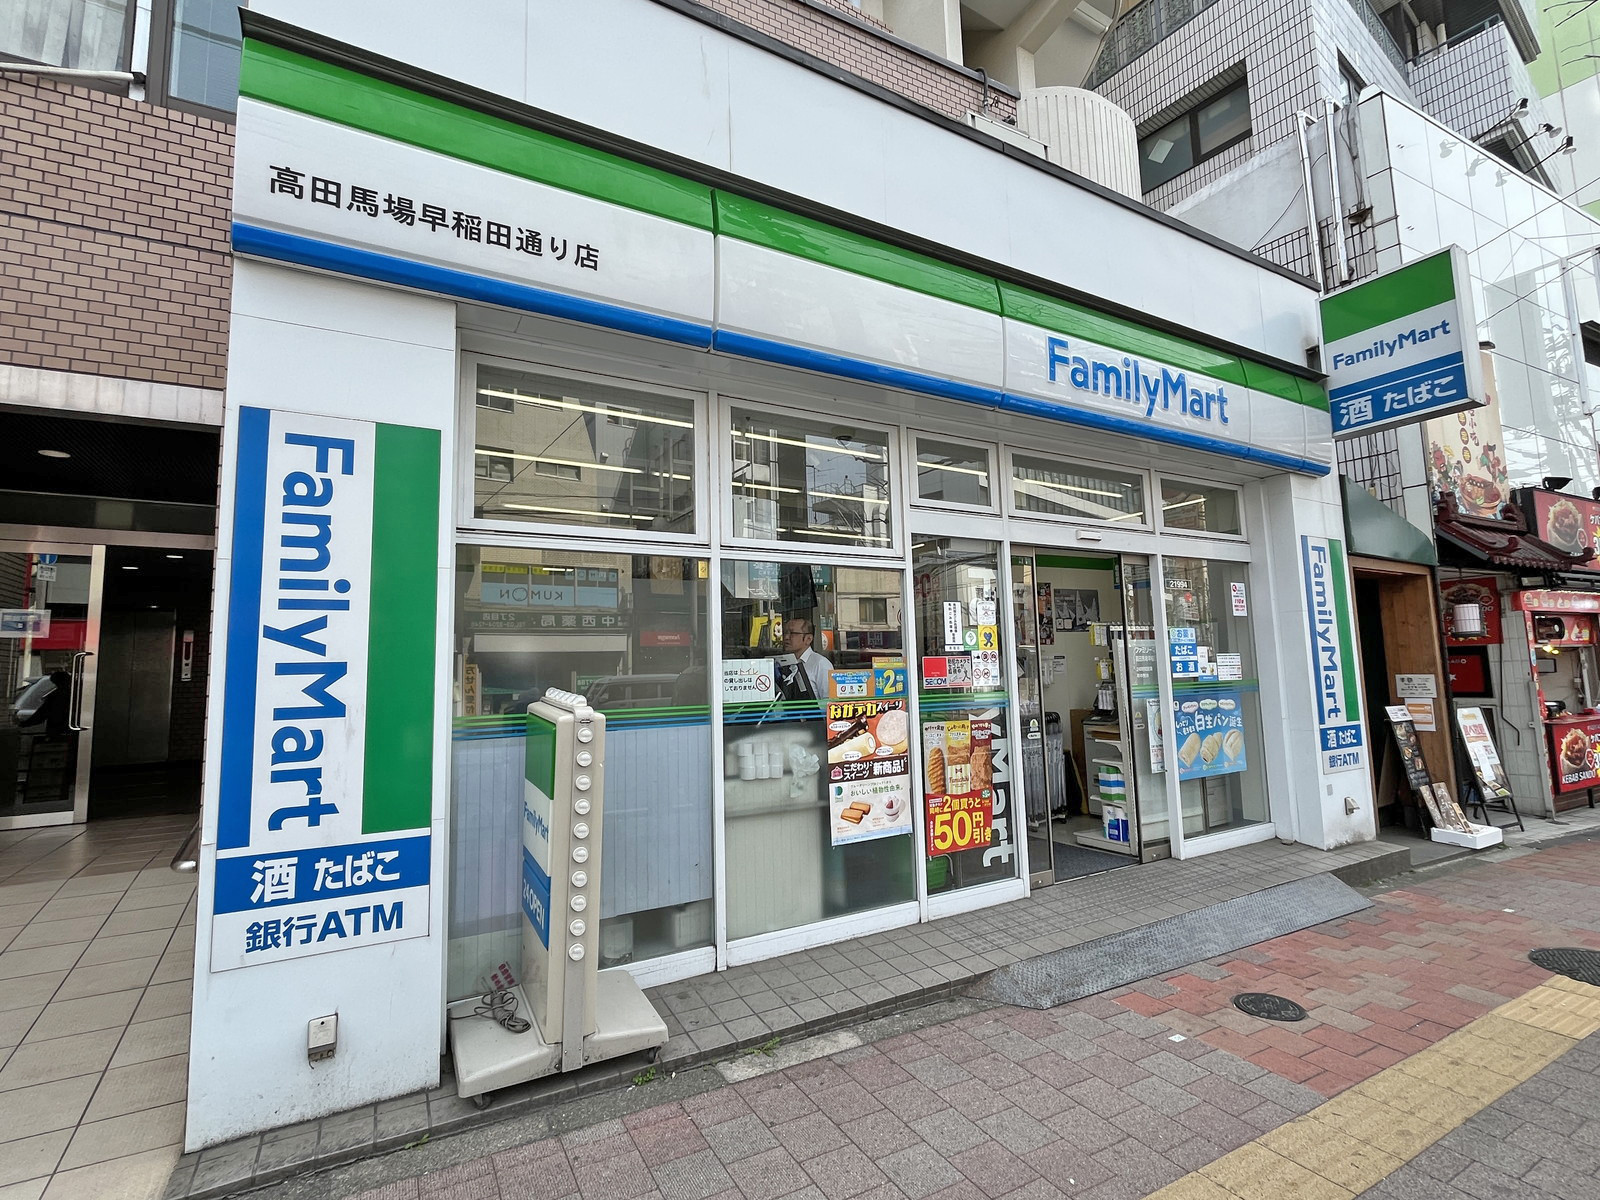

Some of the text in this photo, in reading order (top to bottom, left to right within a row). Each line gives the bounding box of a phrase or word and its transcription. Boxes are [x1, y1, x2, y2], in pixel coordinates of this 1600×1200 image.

[268, 164, 600, 272] 高田馬場早稲田通り店
[1333, 319, 1451, 371] FamilyMart
[1046, 335, 1229, 425] FamilyMart
[1339, 375, 1457, 427] 酒 たばこ
[262, 431, 355, 832] FamilyMart
[1174, 645, 1194, 655] たばこ
[1310, 545, 1342, 719] FamilyMart
[925, 677, 947, 686] SECOM
[1326, 729, 1358, 748] 酒 たばこ
[1328, 751, 1360, 769] 銀行ATM
[843, 763, 870, 772] こだわり
[843, 770, 870, 781] スイーツ
[1562, 773, 1579, 784] KEBAB
[249, 849, 401, 904] 酒 たばこ
[245, 901, 404, 954] 銀行ATM
[529, 887, 545, 931] OPEN
